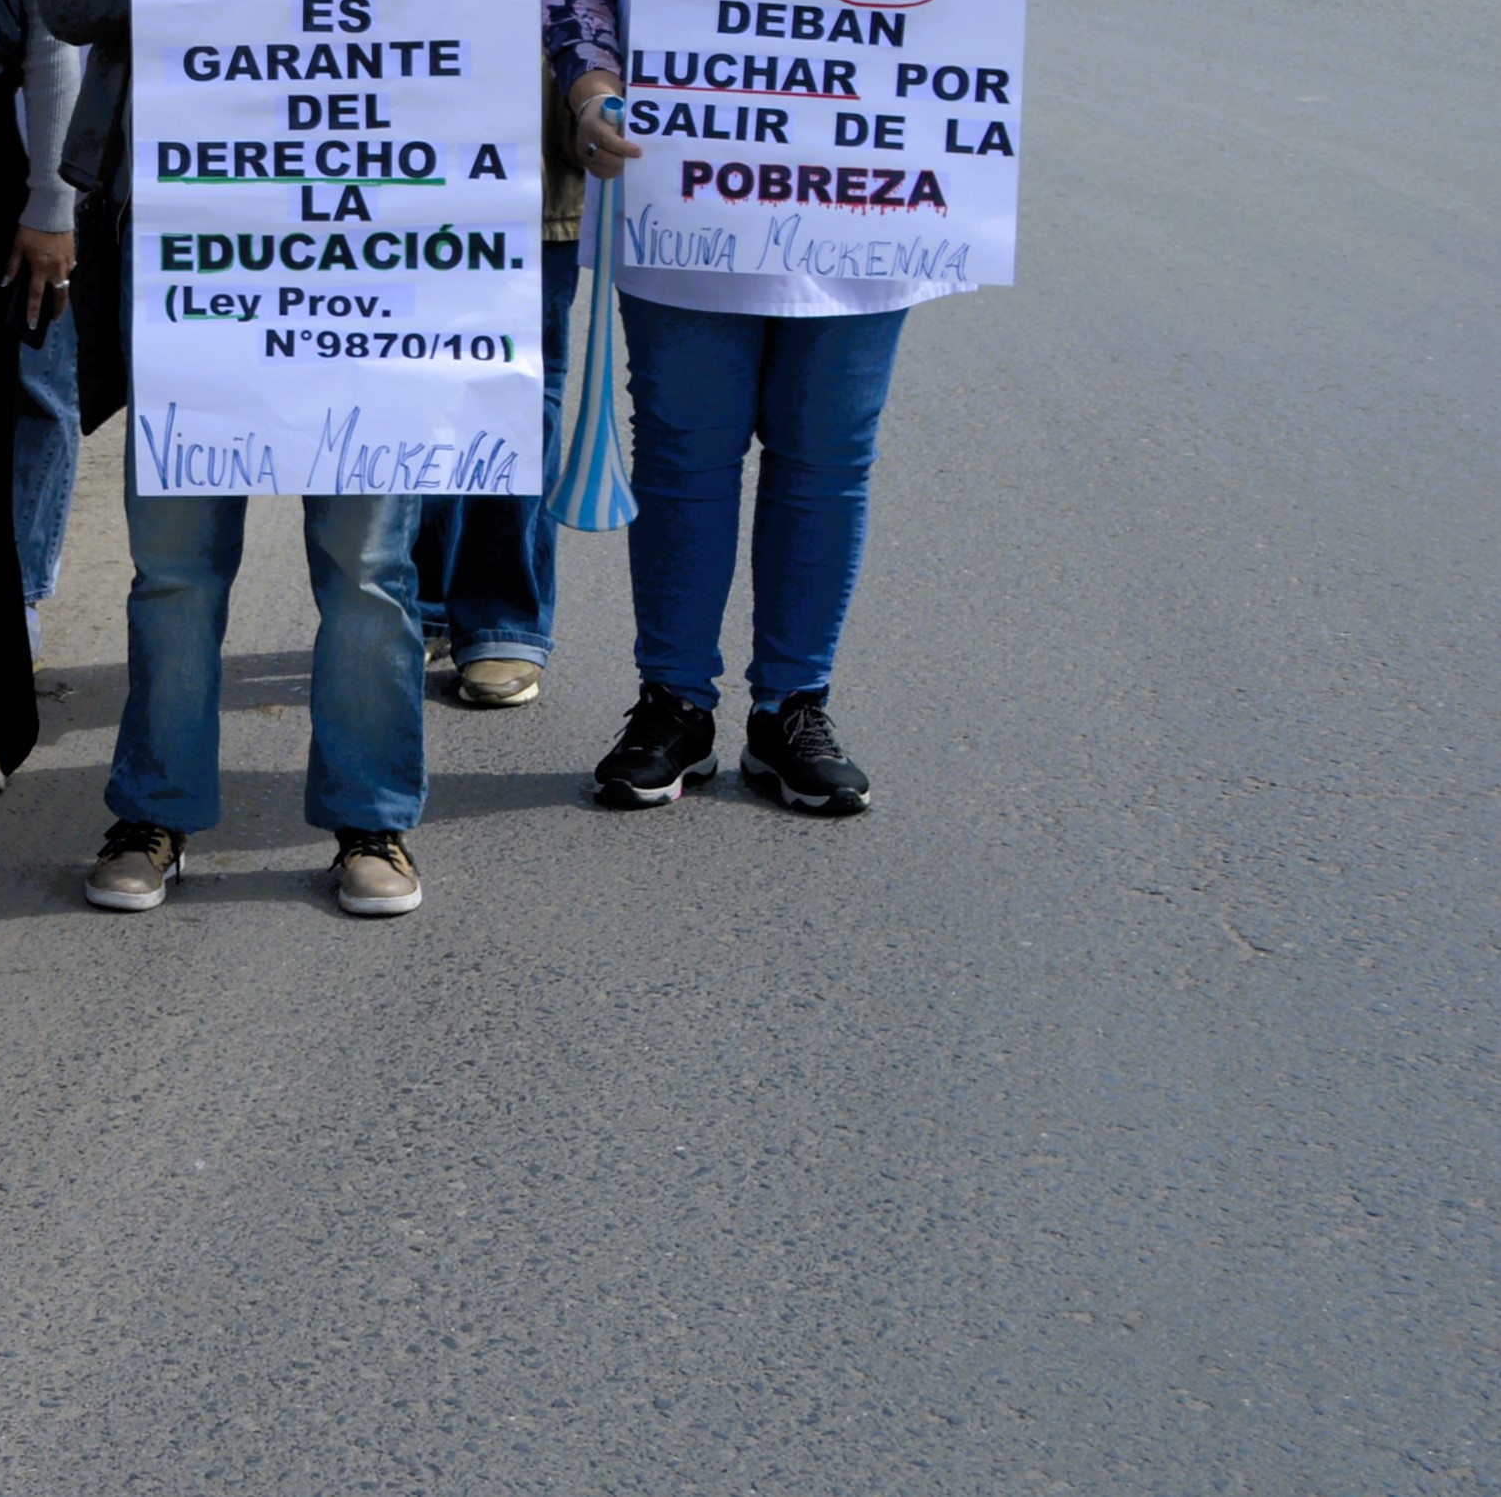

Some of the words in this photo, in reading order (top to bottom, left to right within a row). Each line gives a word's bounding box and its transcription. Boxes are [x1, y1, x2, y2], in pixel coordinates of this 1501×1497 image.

[717, 1, 907, 47] DEBAN
[183, 39, 461, 82] GARANTE
[631, 50, 859, 97] LUCHAR
[896, 64, 1010, 104] POR
[287, 93, 391, 131] DEL
[628, 101, 788, 144] SALIR
[835, 112, 905, 151] DE
[945, 118, 1015, 157] LA
[157, 139, 438, 179] DERECHO
[468, 143, 507, 180] A
[301, 185, 372, 222] LA
[681, 160, 949, 209] POBREZA
[160, 224, 525, 273] EDUCACIÓN.
[164, 285, 261, 323] (Ley
[279, 287, 392, 318] Prov.
